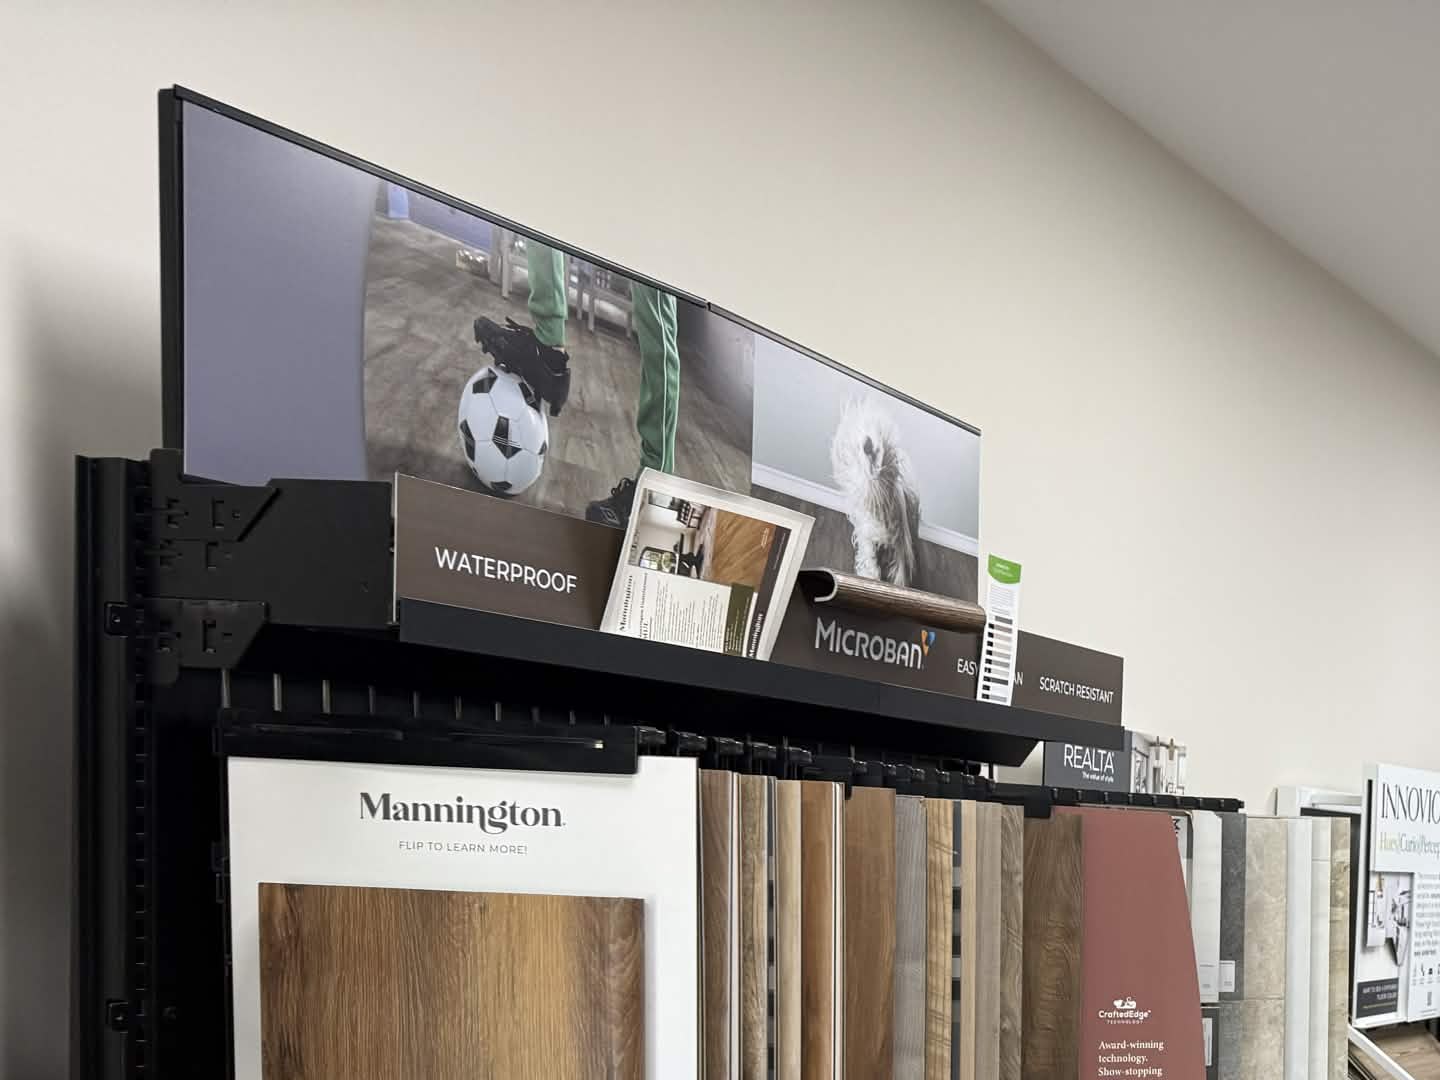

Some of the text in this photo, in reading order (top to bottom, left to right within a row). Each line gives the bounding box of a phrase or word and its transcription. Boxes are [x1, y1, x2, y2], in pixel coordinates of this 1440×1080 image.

[434, 546, 577, 593] WATERPROOF
[815, 616, 922, 670] MICROBAN
[1039, 676, 1075, 697] SCRATCH
[1076, 685, 1114, 705] RESISTANT
[1064, 744, 1114, 774] REALTA
[360, 792, 563, 835] Mannington
[399, 840, 528, 855] FLIP TO LEARN MORE!
[1098, 1040, 1165, 1051] Award-winning
[1098, 1053, 1149, 1065] technology.
[1098, 1067, 1163, 1077] Show-stopping
